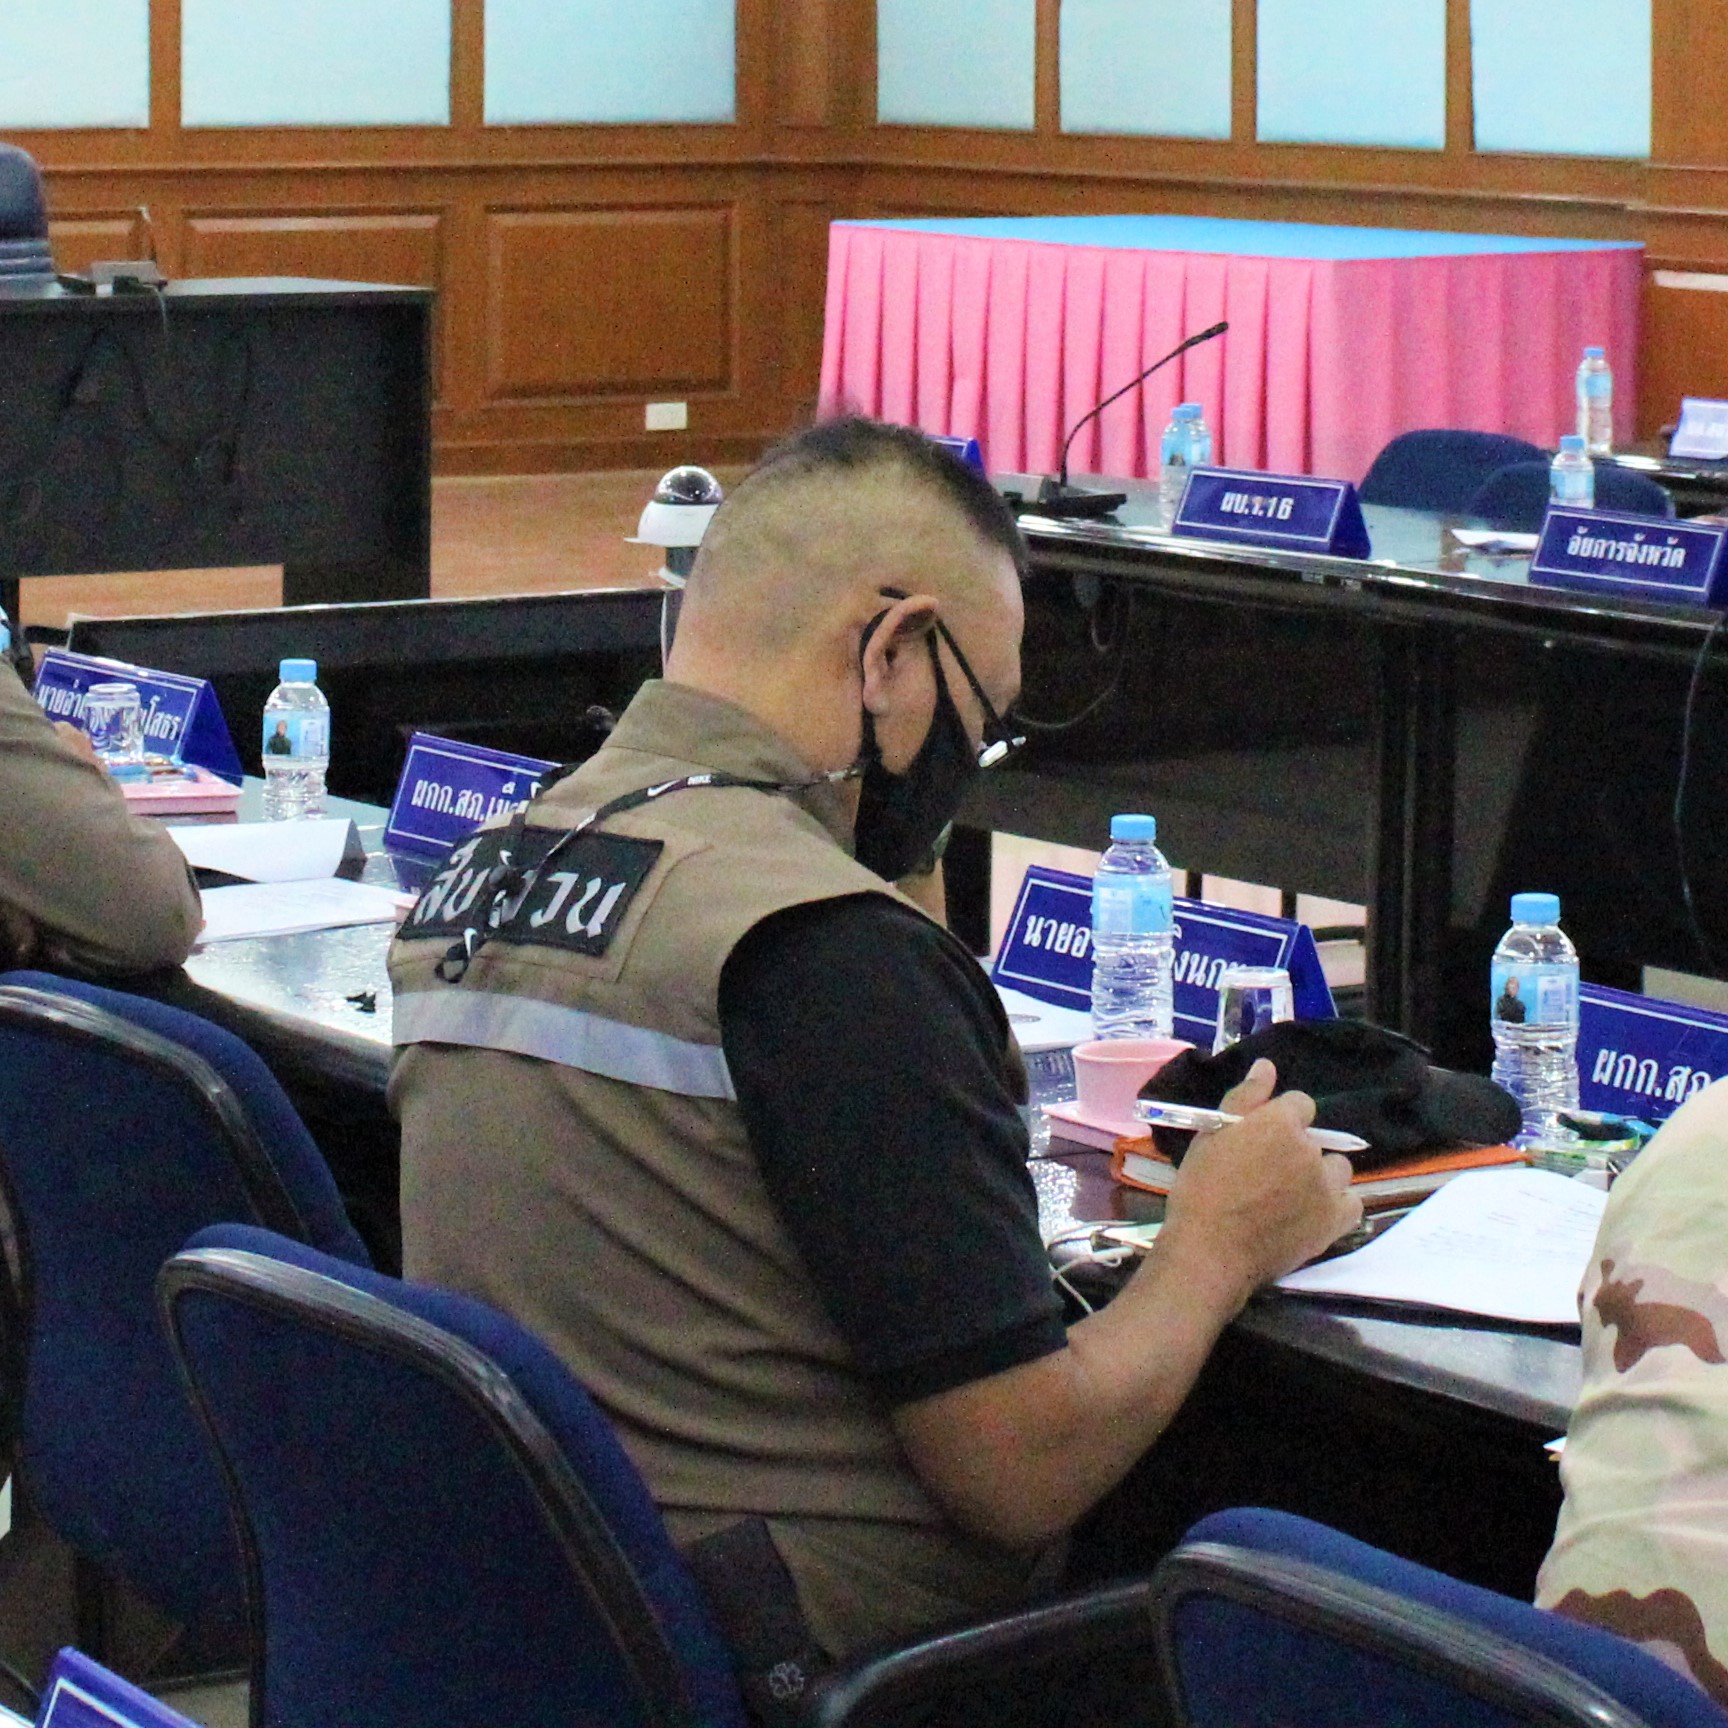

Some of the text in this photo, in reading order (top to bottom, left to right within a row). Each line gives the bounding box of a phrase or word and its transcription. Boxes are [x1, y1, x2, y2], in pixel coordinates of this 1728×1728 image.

[1567, 526, 1686, 568] อัยการจังหวัด
